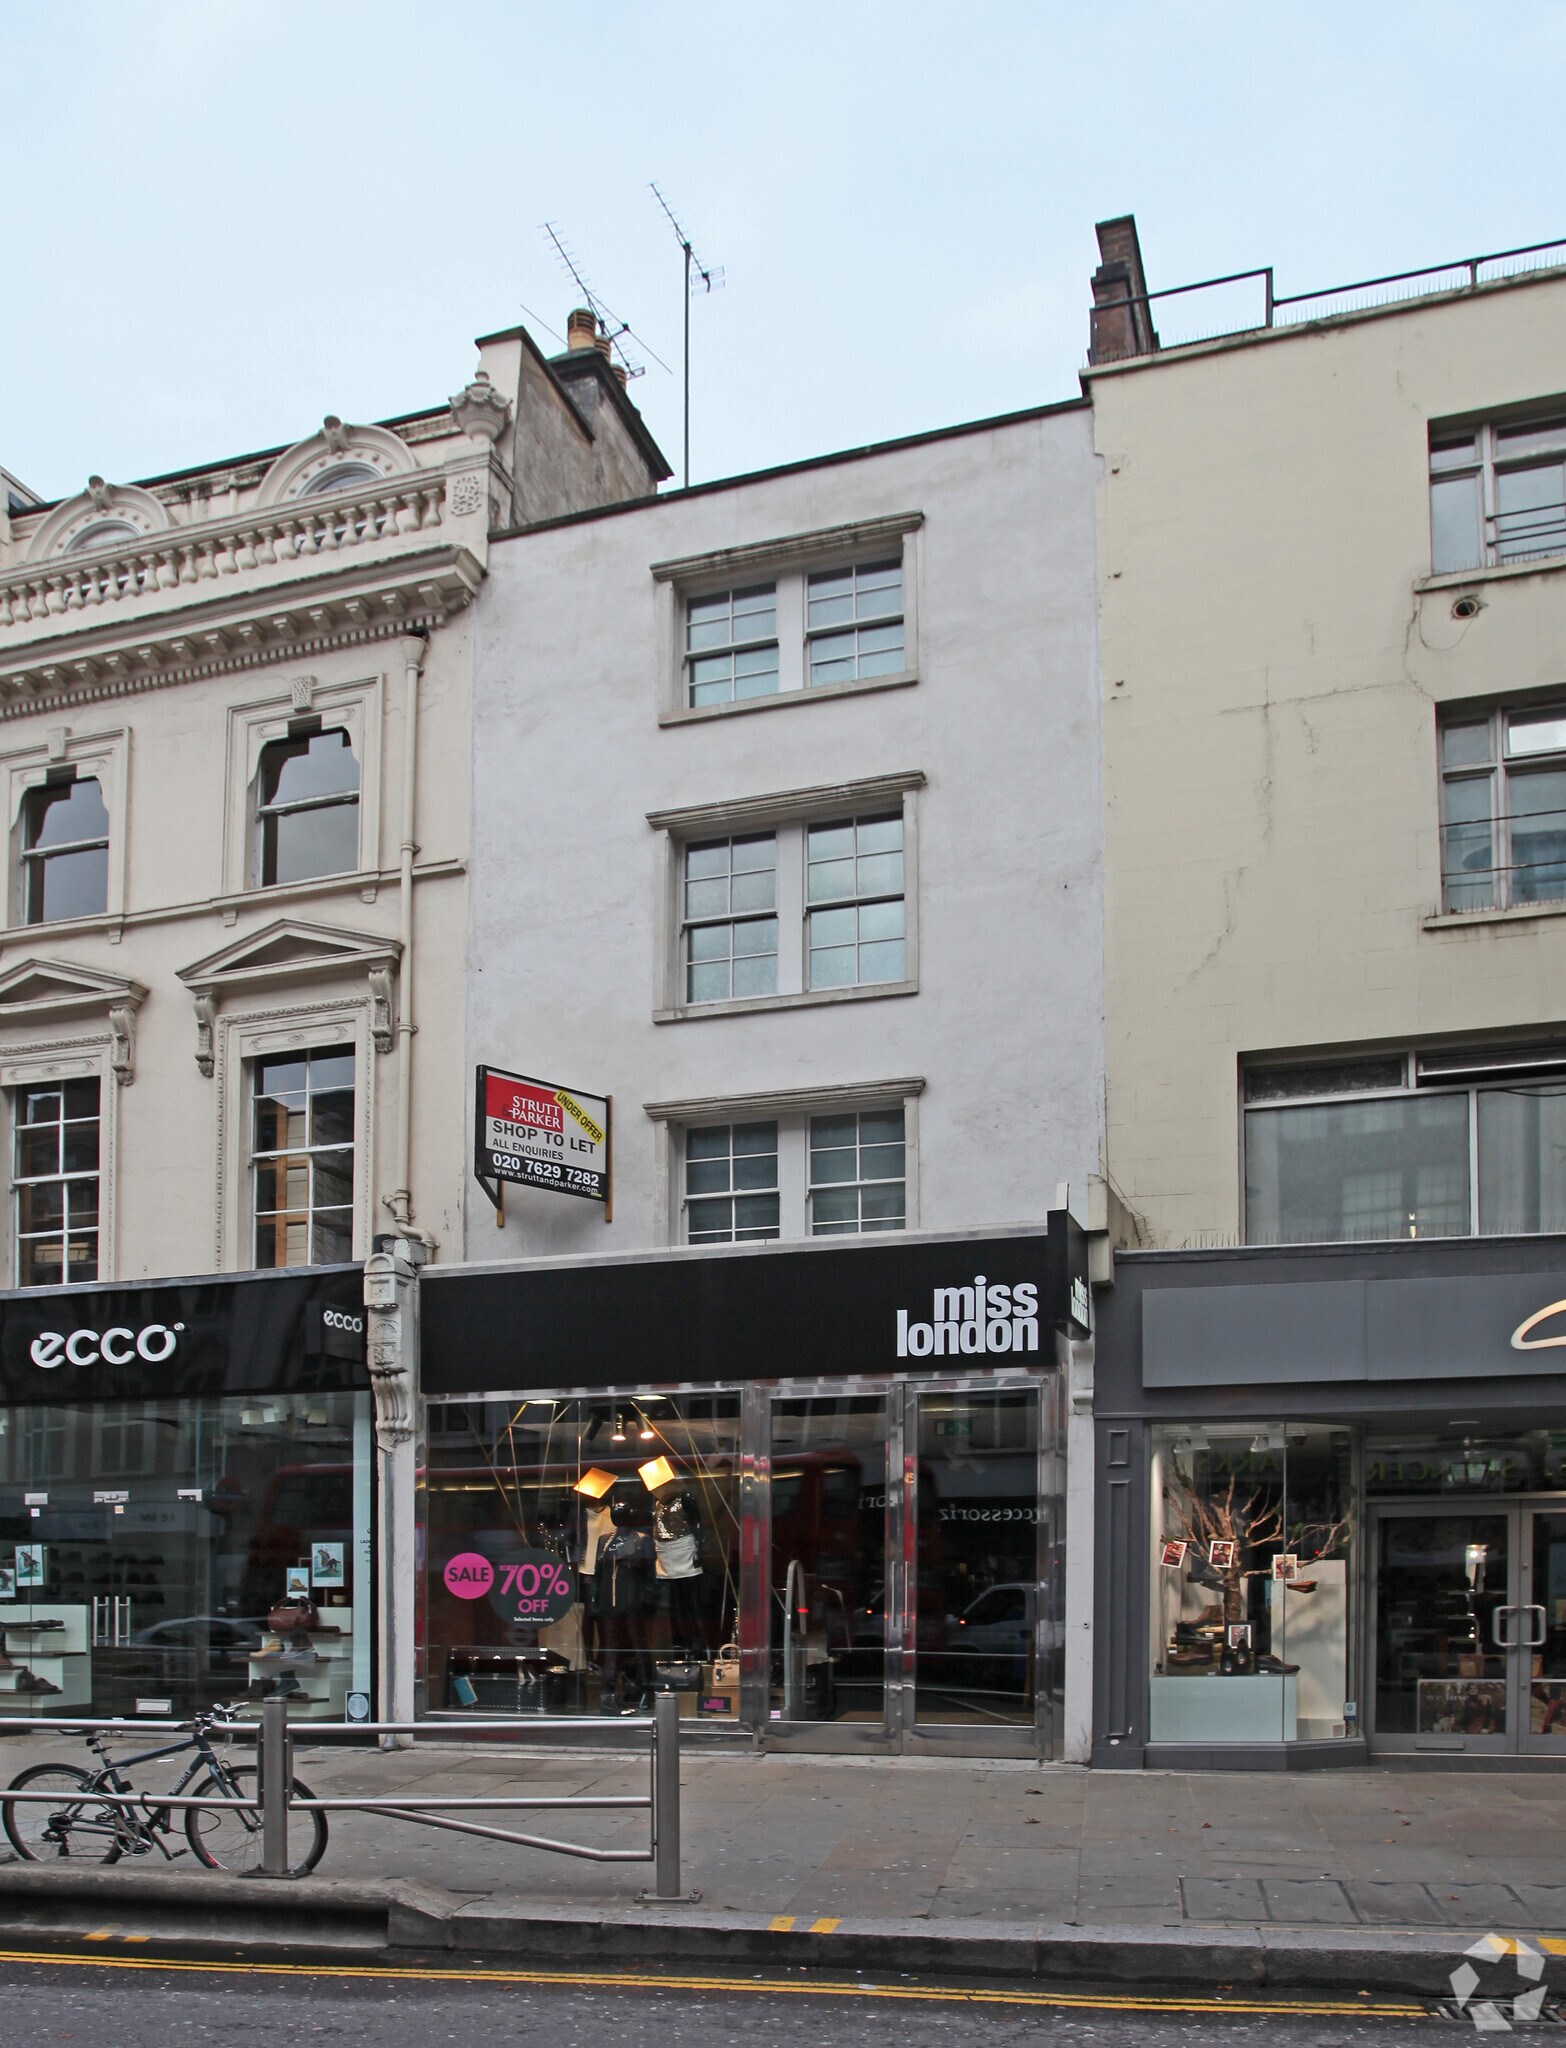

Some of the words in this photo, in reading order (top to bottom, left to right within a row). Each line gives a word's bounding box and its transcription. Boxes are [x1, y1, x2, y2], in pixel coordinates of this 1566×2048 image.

[512, 1095, 560, 1117] STRUTT
[512, 1107, 561, 1129] PARKER
[557, 1091, 582, 1119] UNDER
[580, 1116, 603, 1142] OFFER
[492, 1138, 510, 1150] ALL
[512, 1142, 564, 1161] ENQUIRIES
[493, 1120, 538, 1140] SHOP
[543, 1131, 564, 1147] TO
[570, 1137, 596, 1154] LET
[492, 1153, 521, 1170] 020
[525, 1159, 561, 1178] 7629
[566, 1168, 600, 1187] 7282
[494, 1167, 598, 1194] www.struttandparker.com
[933, 1275, 1039, 1322] miss
[323, 1310, 363, 1333] ecco
[896, 1309, 1039, 1357] london
[30, 1324, 177, 1369] ecco
[448, 1567, 490, 1582] SALE
[499, 1563, 570, 1596] 70%
[518, 1599, 549, 1613] OFF
